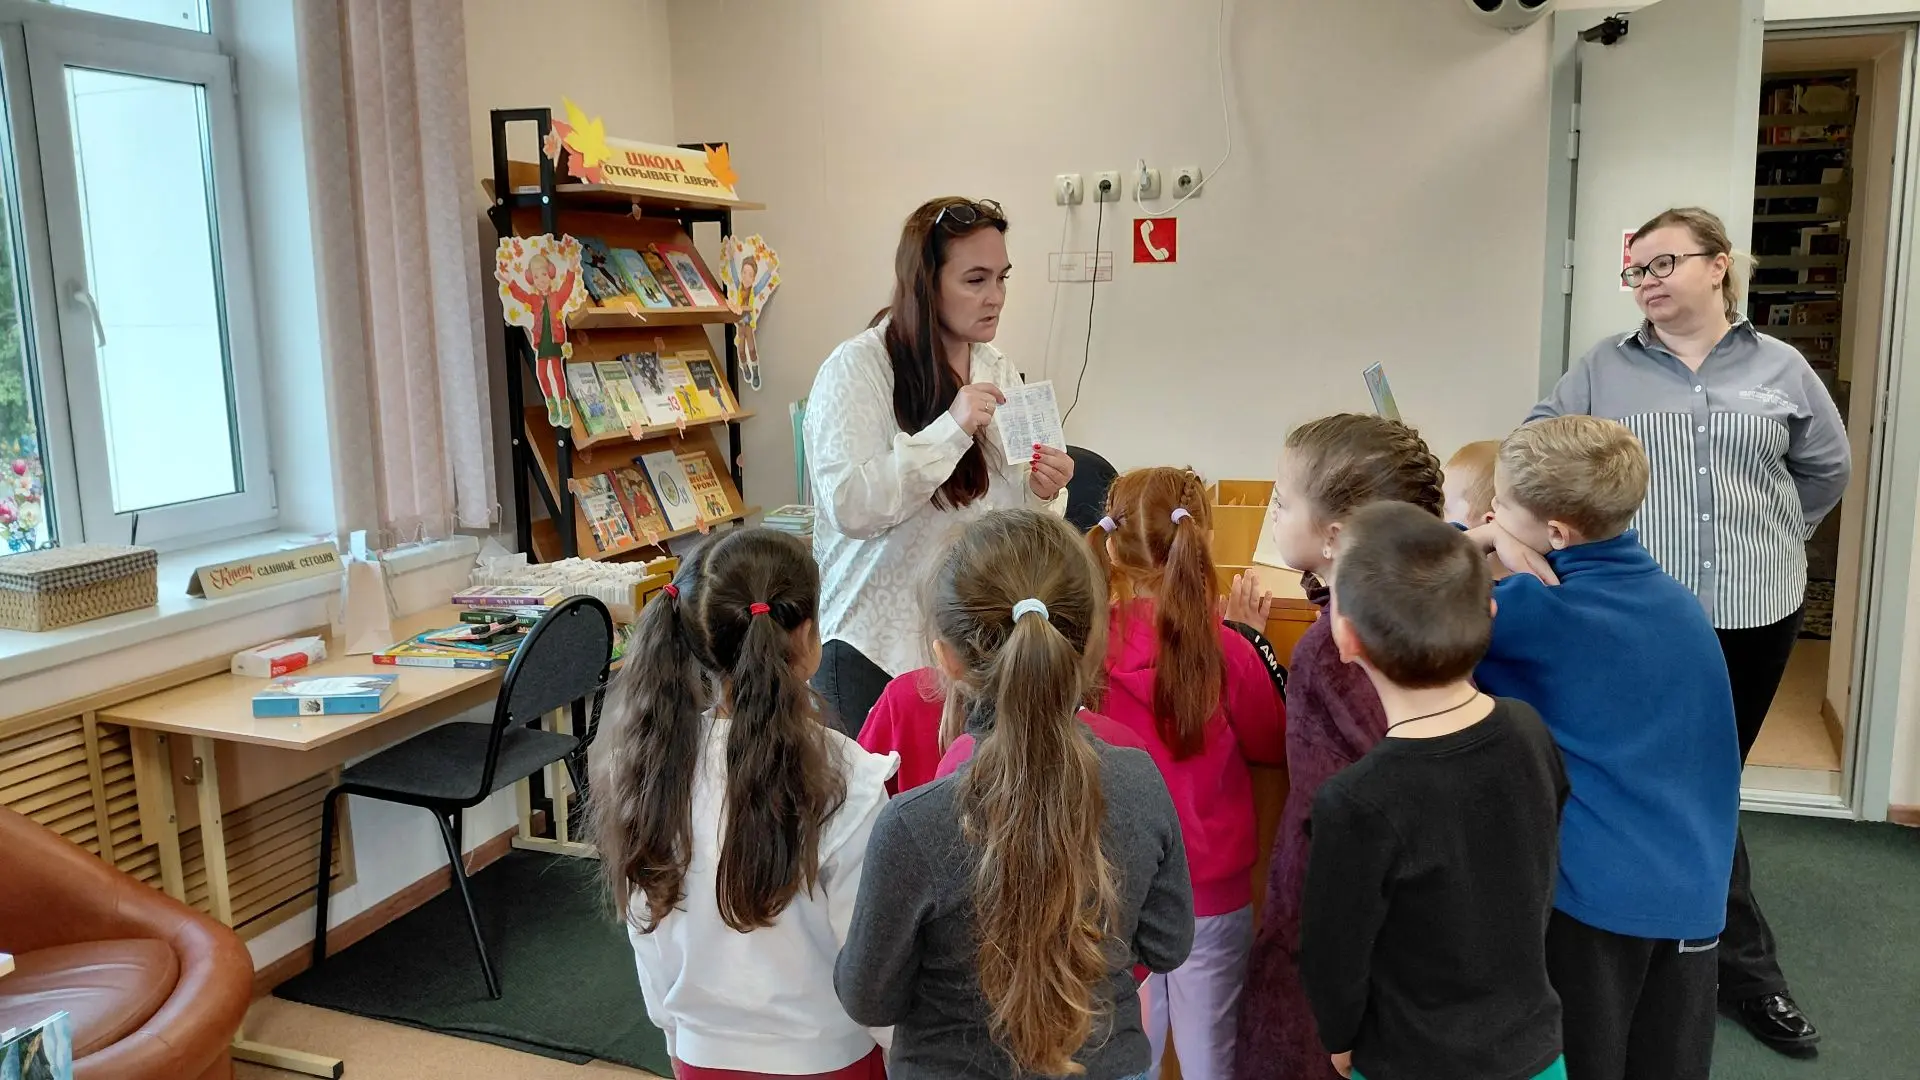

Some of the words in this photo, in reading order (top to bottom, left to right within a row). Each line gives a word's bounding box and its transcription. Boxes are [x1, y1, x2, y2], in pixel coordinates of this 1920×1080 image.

[625, 151, 685, 172] ШКОЛА
[604, 164, 679, 183] ОТКРЫВАЕТ
[256, 559, 297, 577] СДАННЫЕ
[299, 552, 335, 568] СЕГОДНЯ
[1260, 645, 1277, 670] AM
